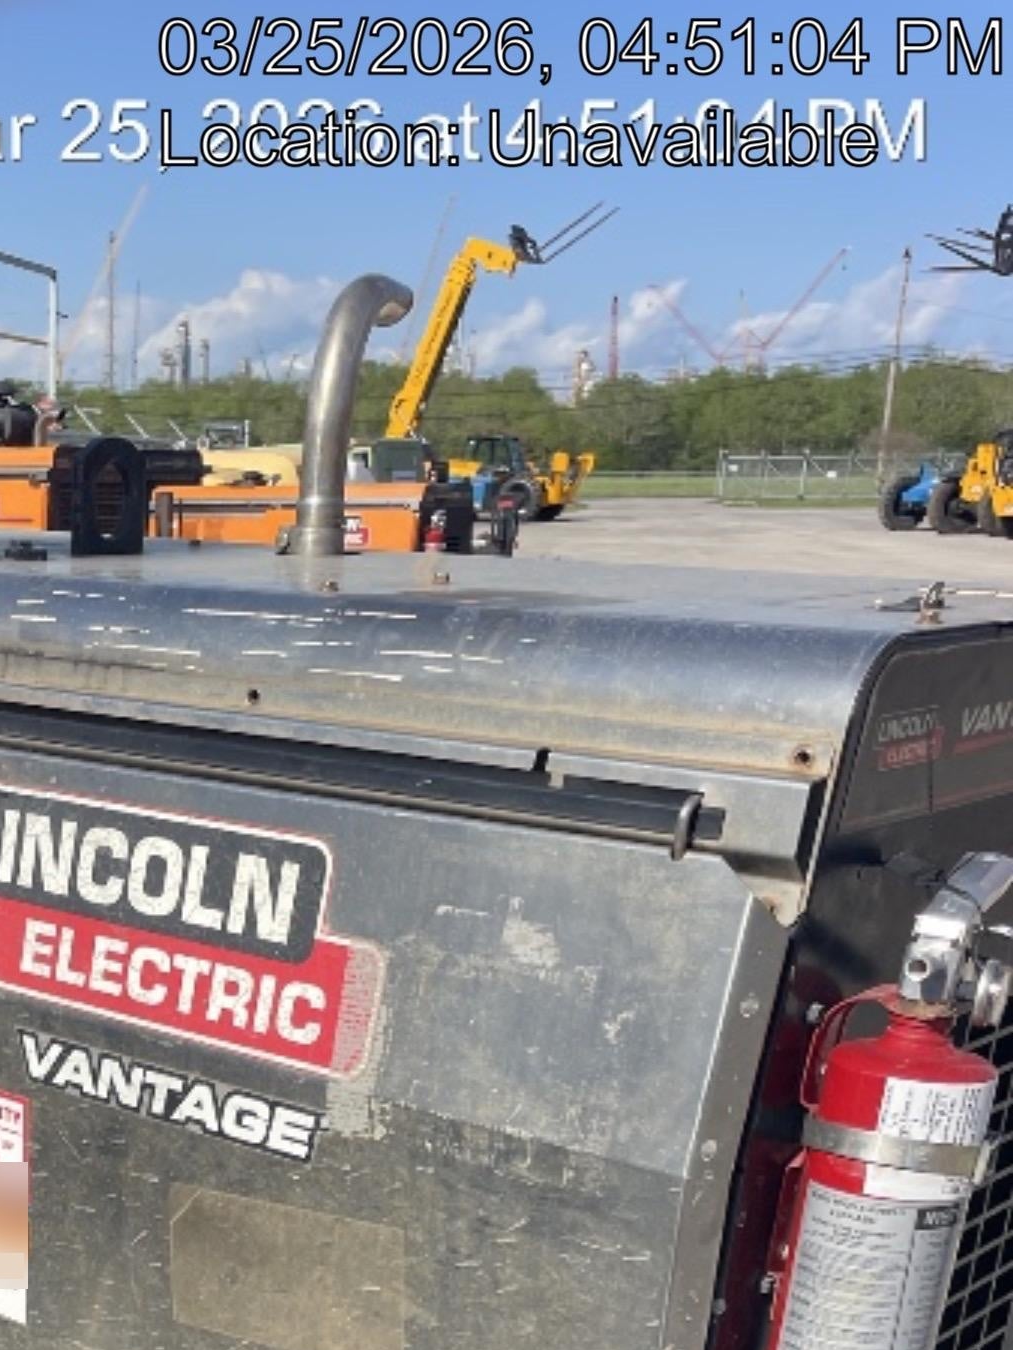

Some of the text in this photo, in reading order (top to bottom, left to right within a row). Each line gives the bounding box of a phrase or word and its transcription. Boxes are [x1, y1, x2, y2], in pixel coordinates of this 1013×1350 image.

[961, 701, 1013, 737] VAN
[19, 917, 328, 1046] ELECTRIC
[18, 1031, 322, 1161] VANTAGE
